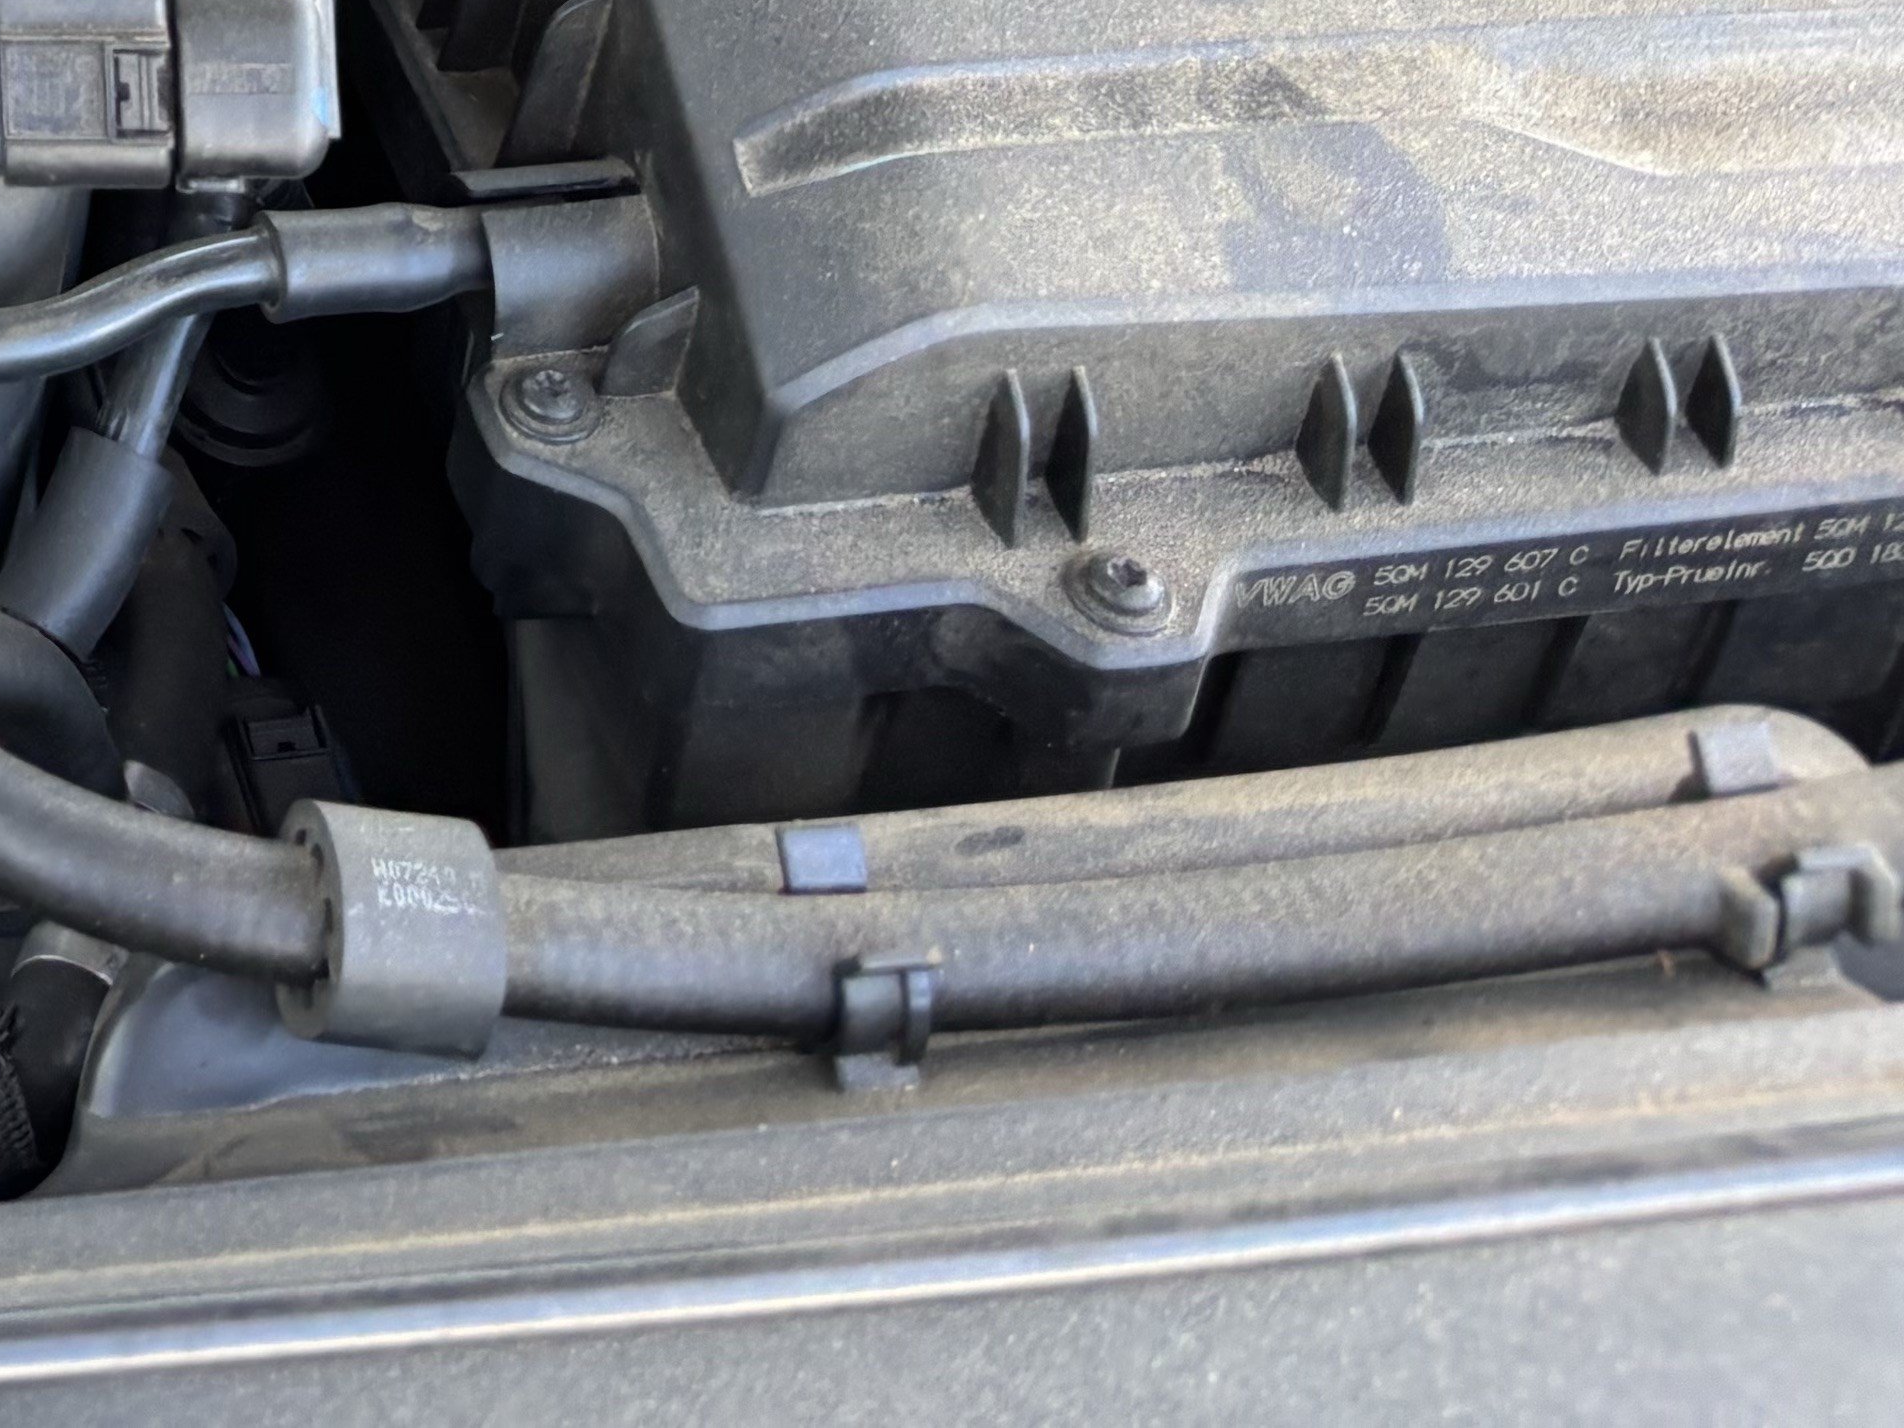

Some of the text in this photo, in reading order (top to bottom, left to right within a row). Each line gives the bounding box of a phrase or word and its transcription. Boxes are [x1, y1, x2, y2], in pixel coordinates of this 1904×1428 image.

[1620, 523, 1804, 562] Filterelement
[1444, 556, 1491, 579] 129
[1504, 550, 1557, 574] 607
[1571, 544, 1590, 566] C
[1434, 587, 1478, 611] 129
[1493, 581, 1541, 605] 601
[1559, 576, 1580, 598] C
